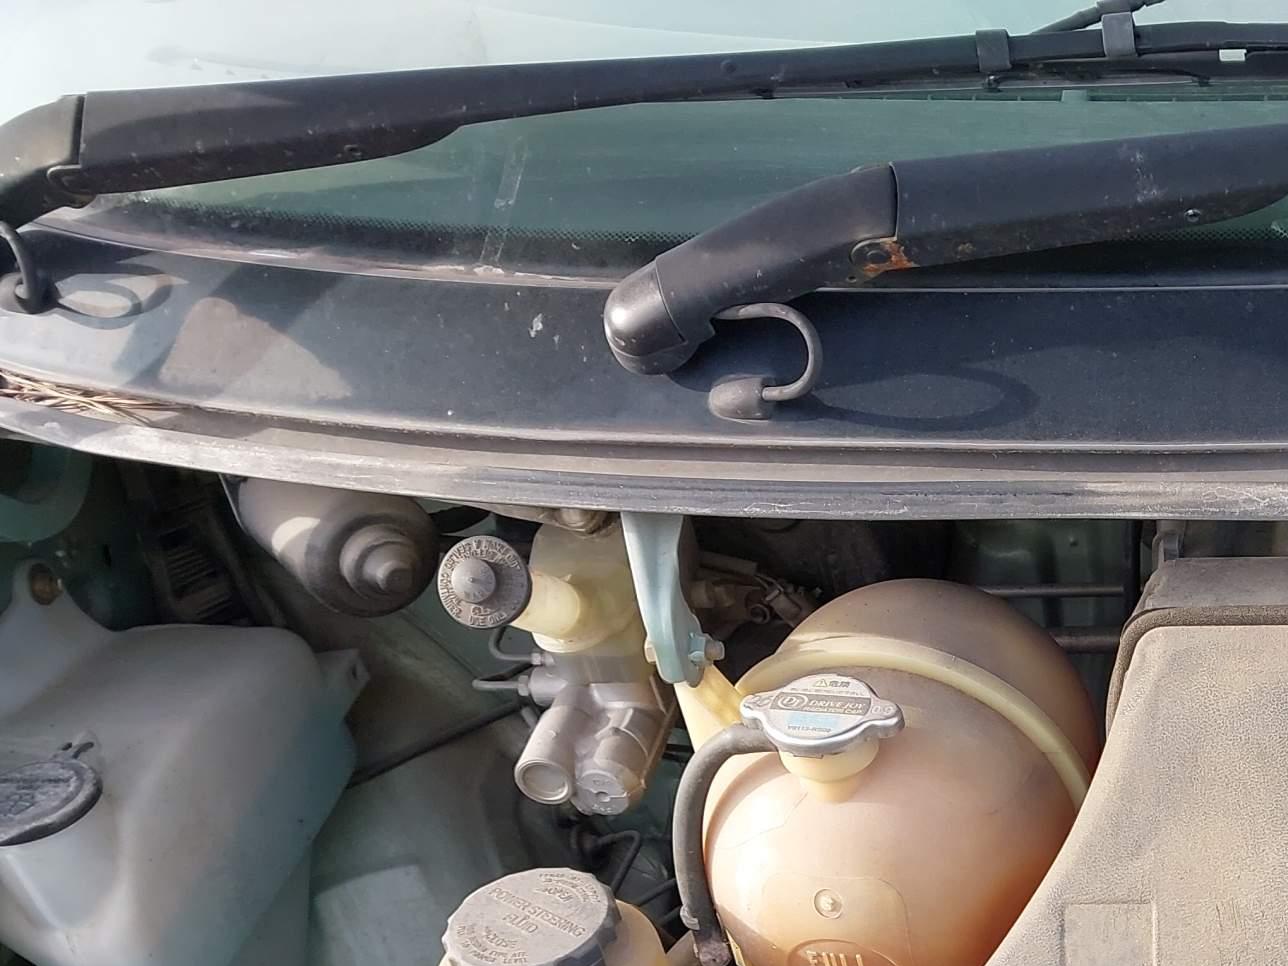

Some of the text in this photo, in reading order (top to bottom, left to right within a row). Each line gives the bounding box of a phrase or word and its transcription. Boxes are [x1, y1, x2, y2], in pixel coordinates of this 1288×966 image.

[485, 886, 534, 911] POWER
[523, 904, 589, 938] STEERING
[499, 912, 541, 934] FLUID
